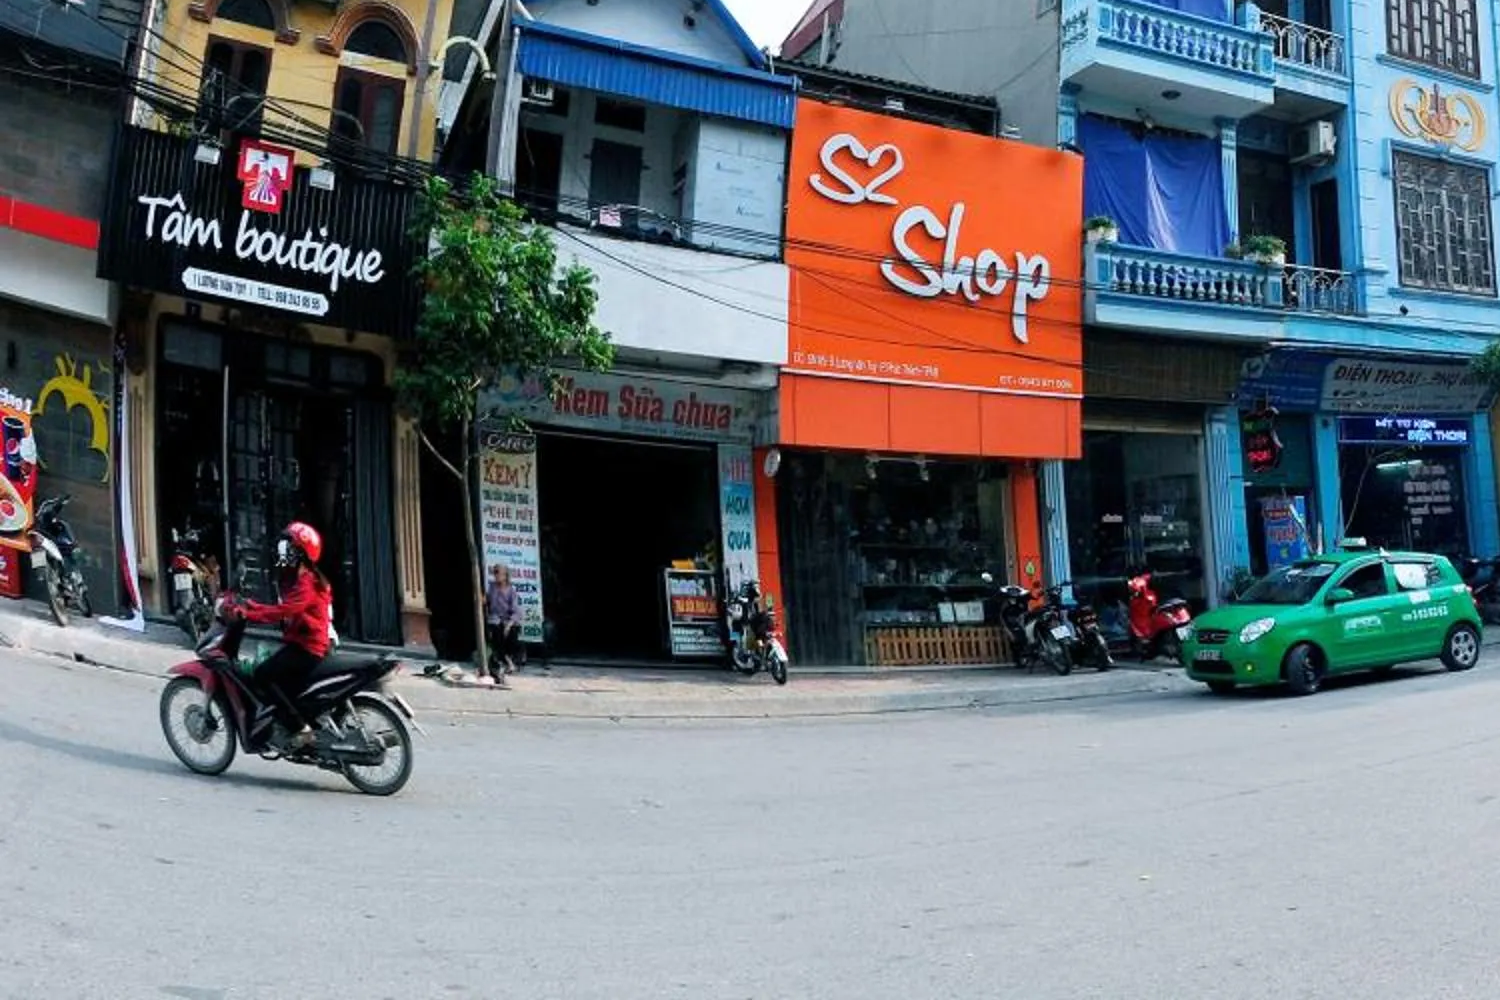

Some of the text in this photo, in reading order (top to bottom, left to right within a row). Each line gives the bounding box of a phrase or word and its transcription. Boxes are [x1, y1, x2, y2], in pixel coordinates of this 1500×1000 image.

[138, 190, 386, 292] Tâm boutique
[880, 202, 1050, 344] Shop
